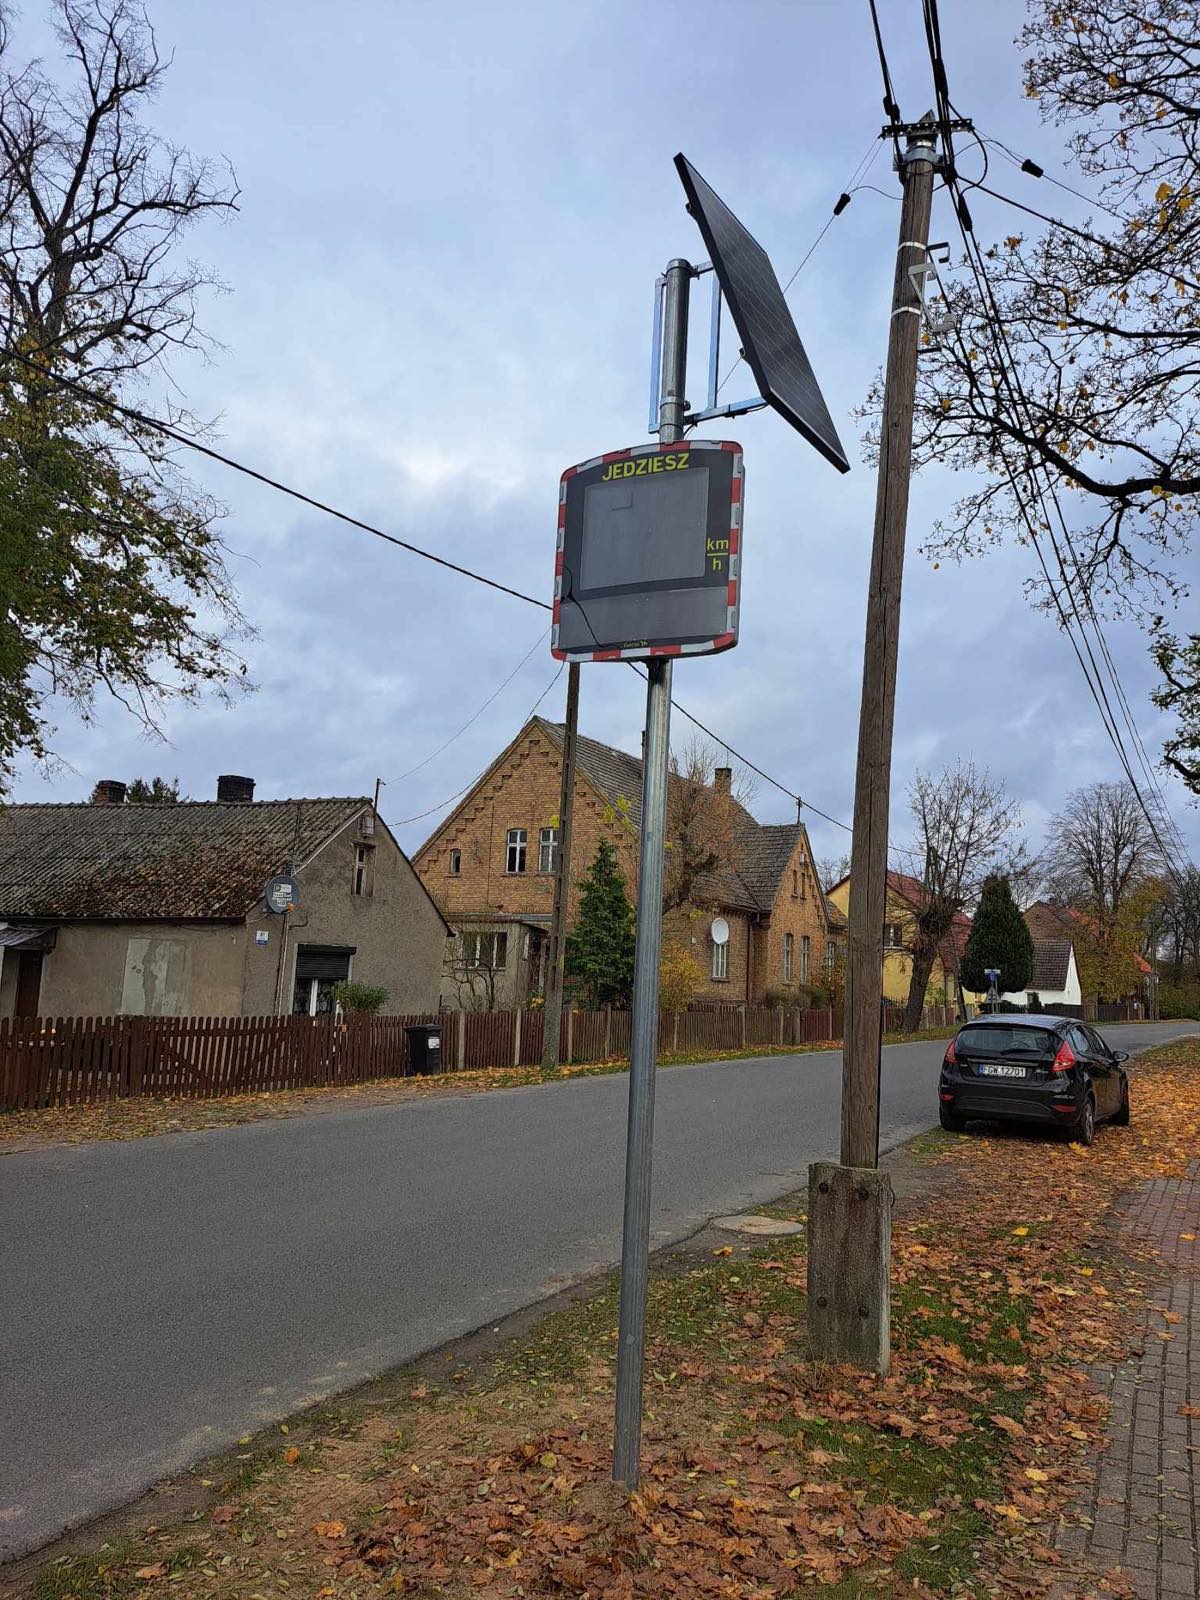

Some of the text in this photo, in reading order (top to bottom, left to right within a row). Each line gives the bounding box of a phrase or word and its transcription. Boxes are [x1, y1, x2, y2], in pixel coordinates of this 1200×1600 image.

[601, 453, 690, 481] JEDZIESZ
[707, 537, 729, 550] km
[712, 557, 721, 571] h
[1001, 1066, 1025, 1077] 12701
